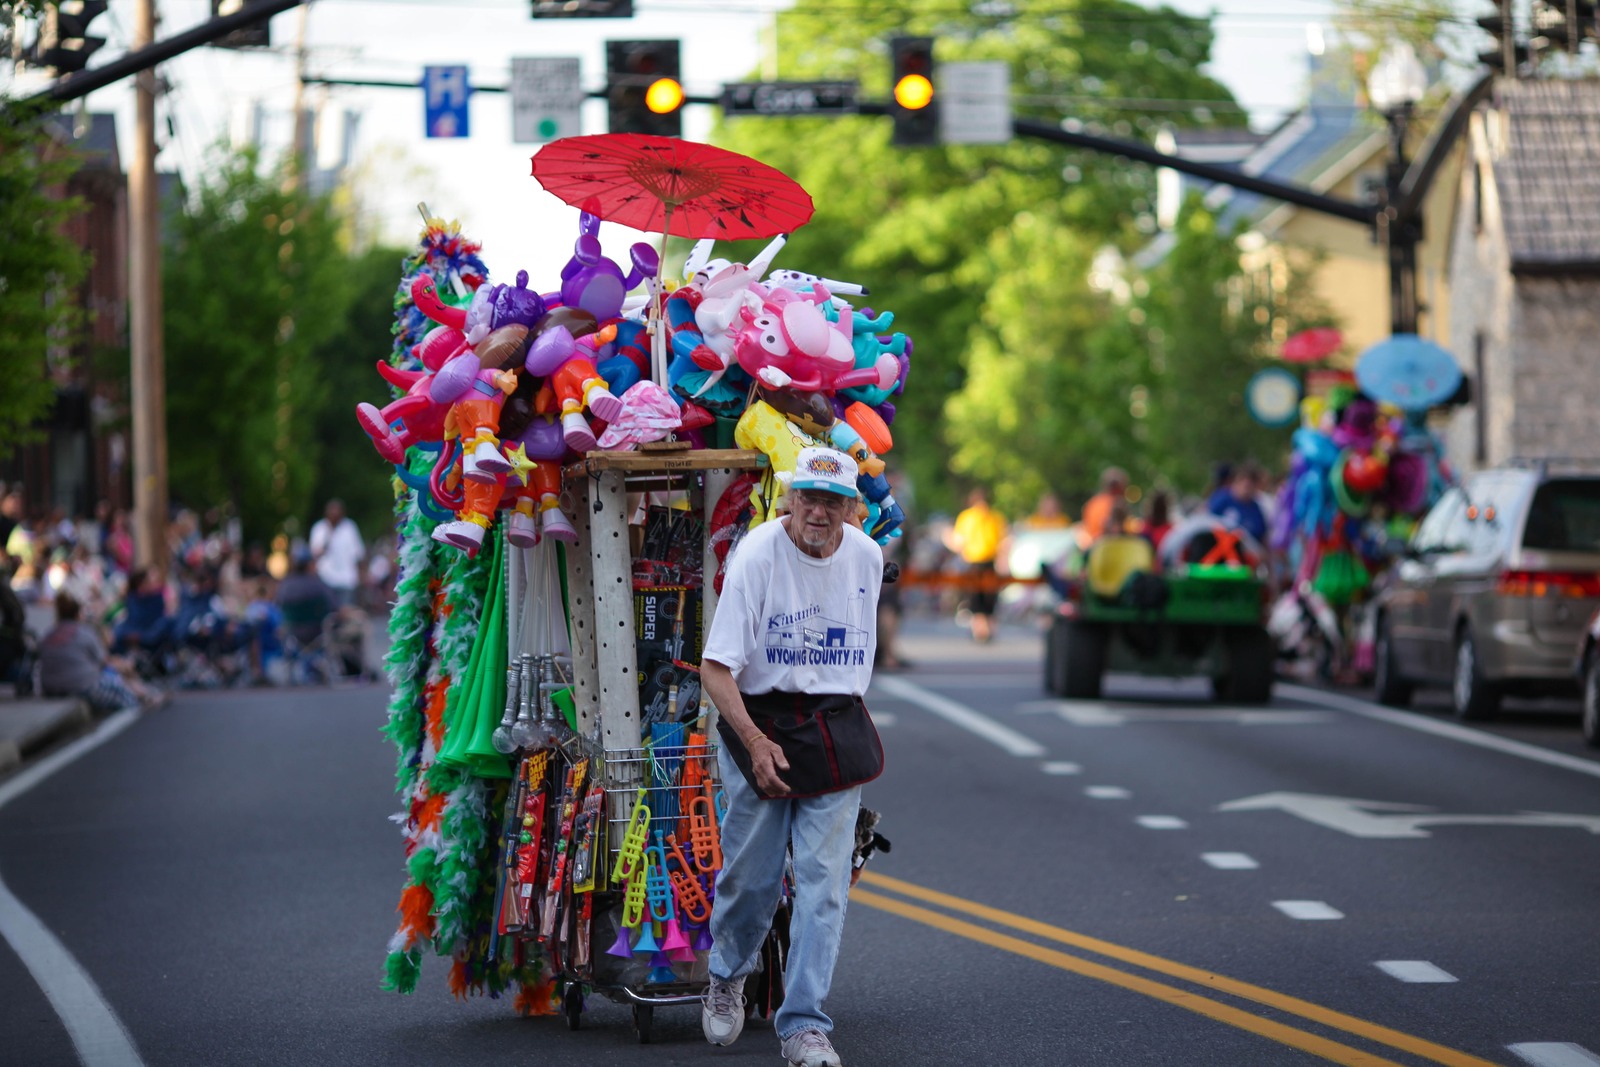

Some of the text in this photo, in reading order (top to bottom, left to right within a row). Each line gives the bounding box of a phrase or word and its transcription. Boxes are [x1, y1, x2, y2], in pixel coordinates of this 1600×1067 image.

[644, 596, 656, 640] SUPER
[765, 647, 807, 666] WYOMNG
[808, 649, 851, 666] COUNTY
[528, 750, 548, 767] SOFT
[529, 761, 548, 776] DART
